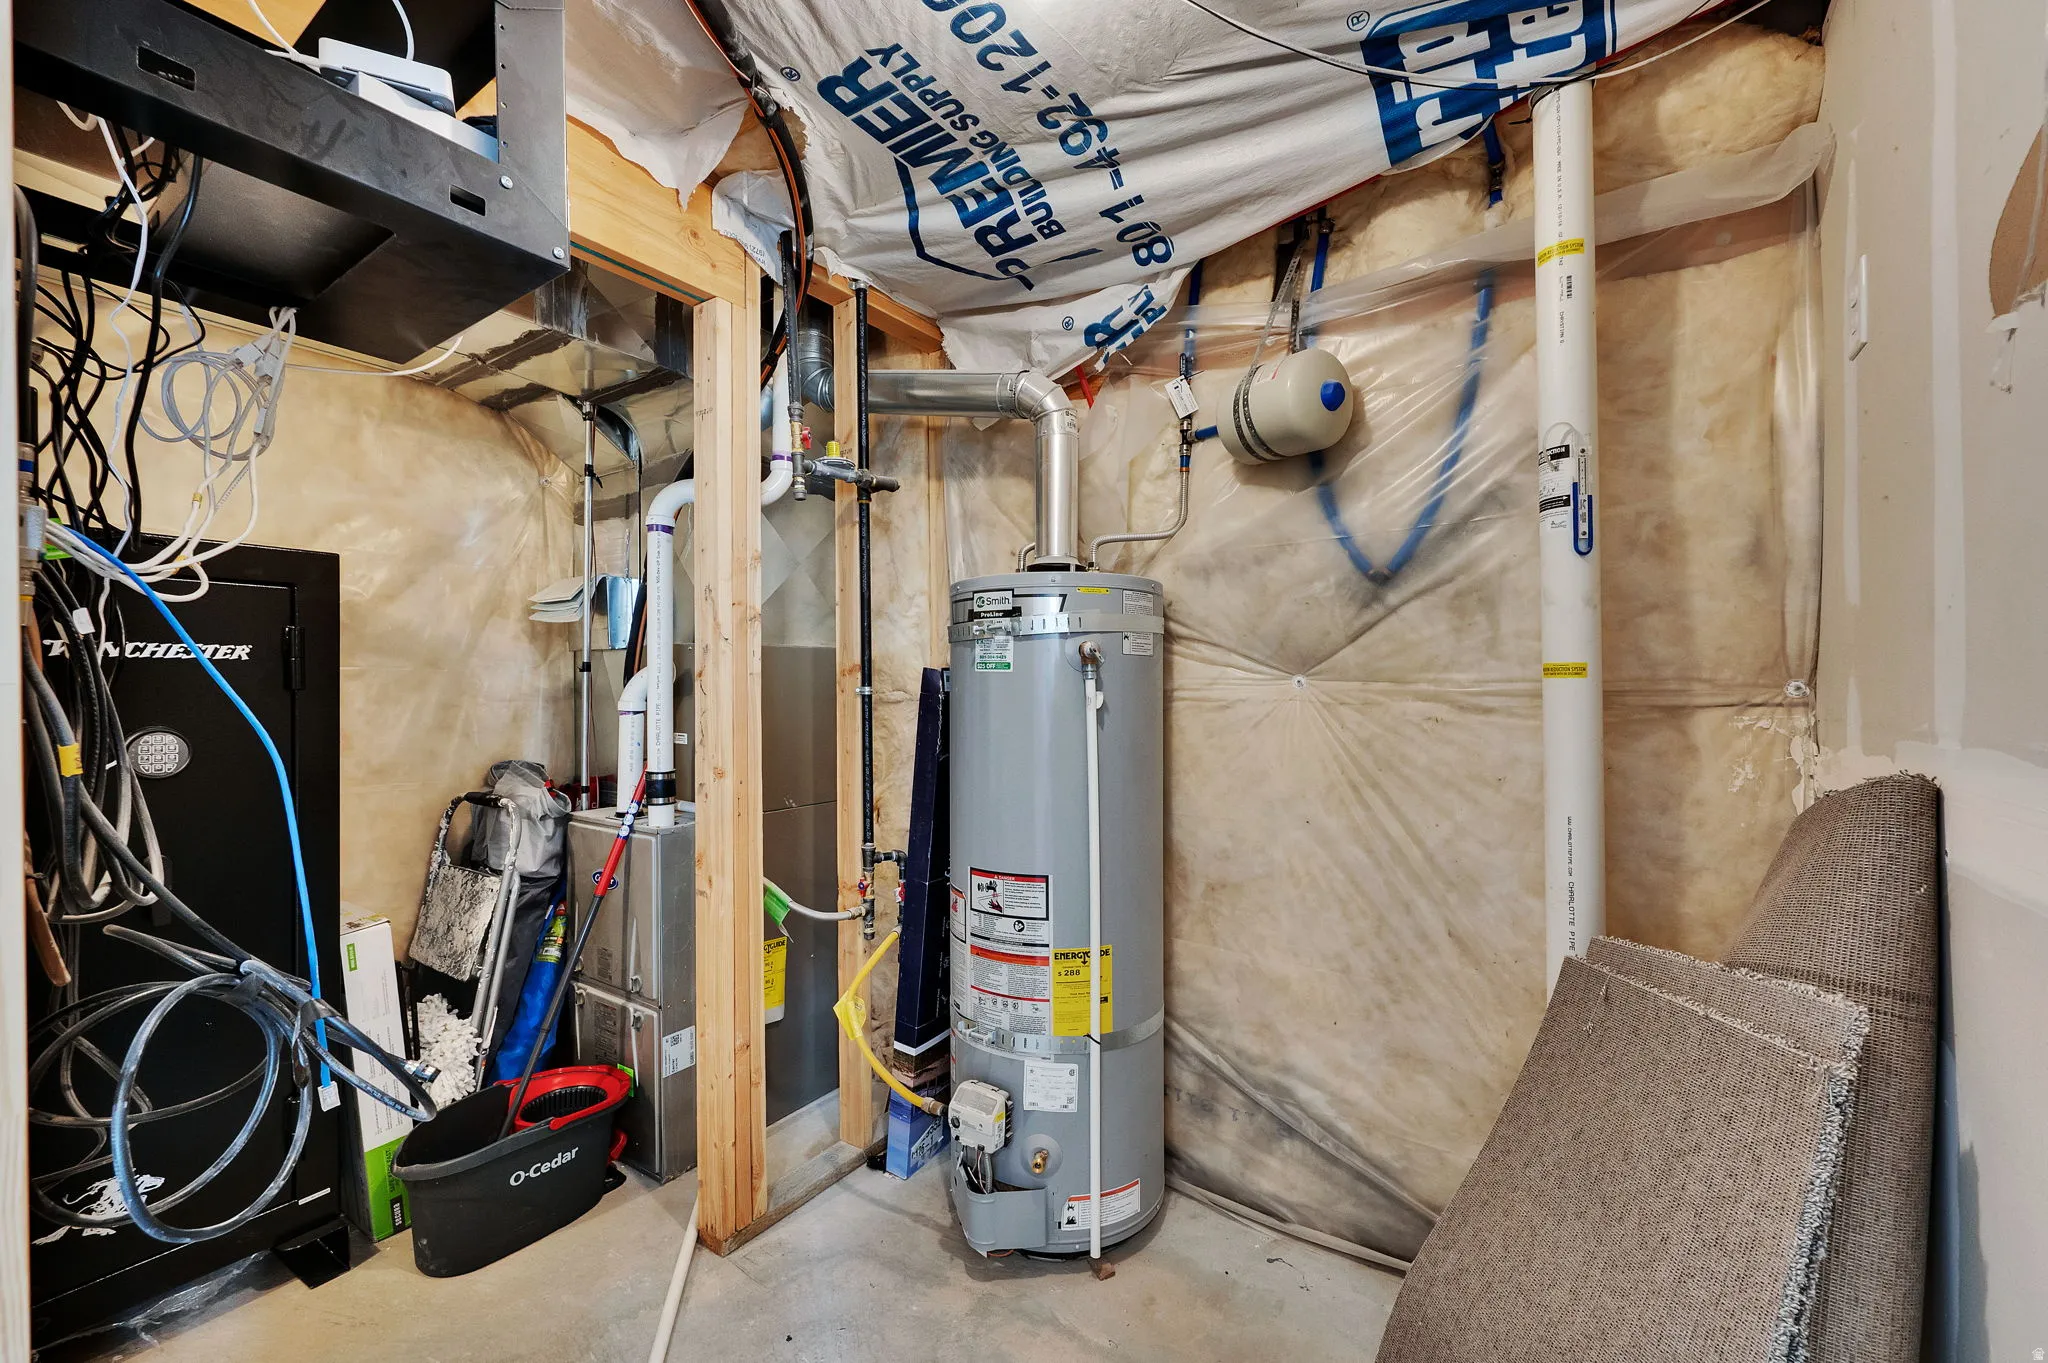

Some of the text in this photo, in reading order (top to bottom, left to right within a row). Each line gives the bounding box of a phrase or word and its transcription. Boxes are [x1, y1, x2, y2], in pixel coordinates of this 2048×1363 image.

[864, 43, 1067, 240] BUILDING SUPPLY
[920, 0, 1175, 268] 801-492-120
[816, 56, 1038, 291] PREMIER
[986, 596, 1010, 606] Smith
[42, 639, 252, 661] WNCHESTER
[1054, 948, 1111, 962] ENERGYGDE
[1064, 969, 1081, 977] 288
[509, 1145, 580, 1188] O-Cedar
